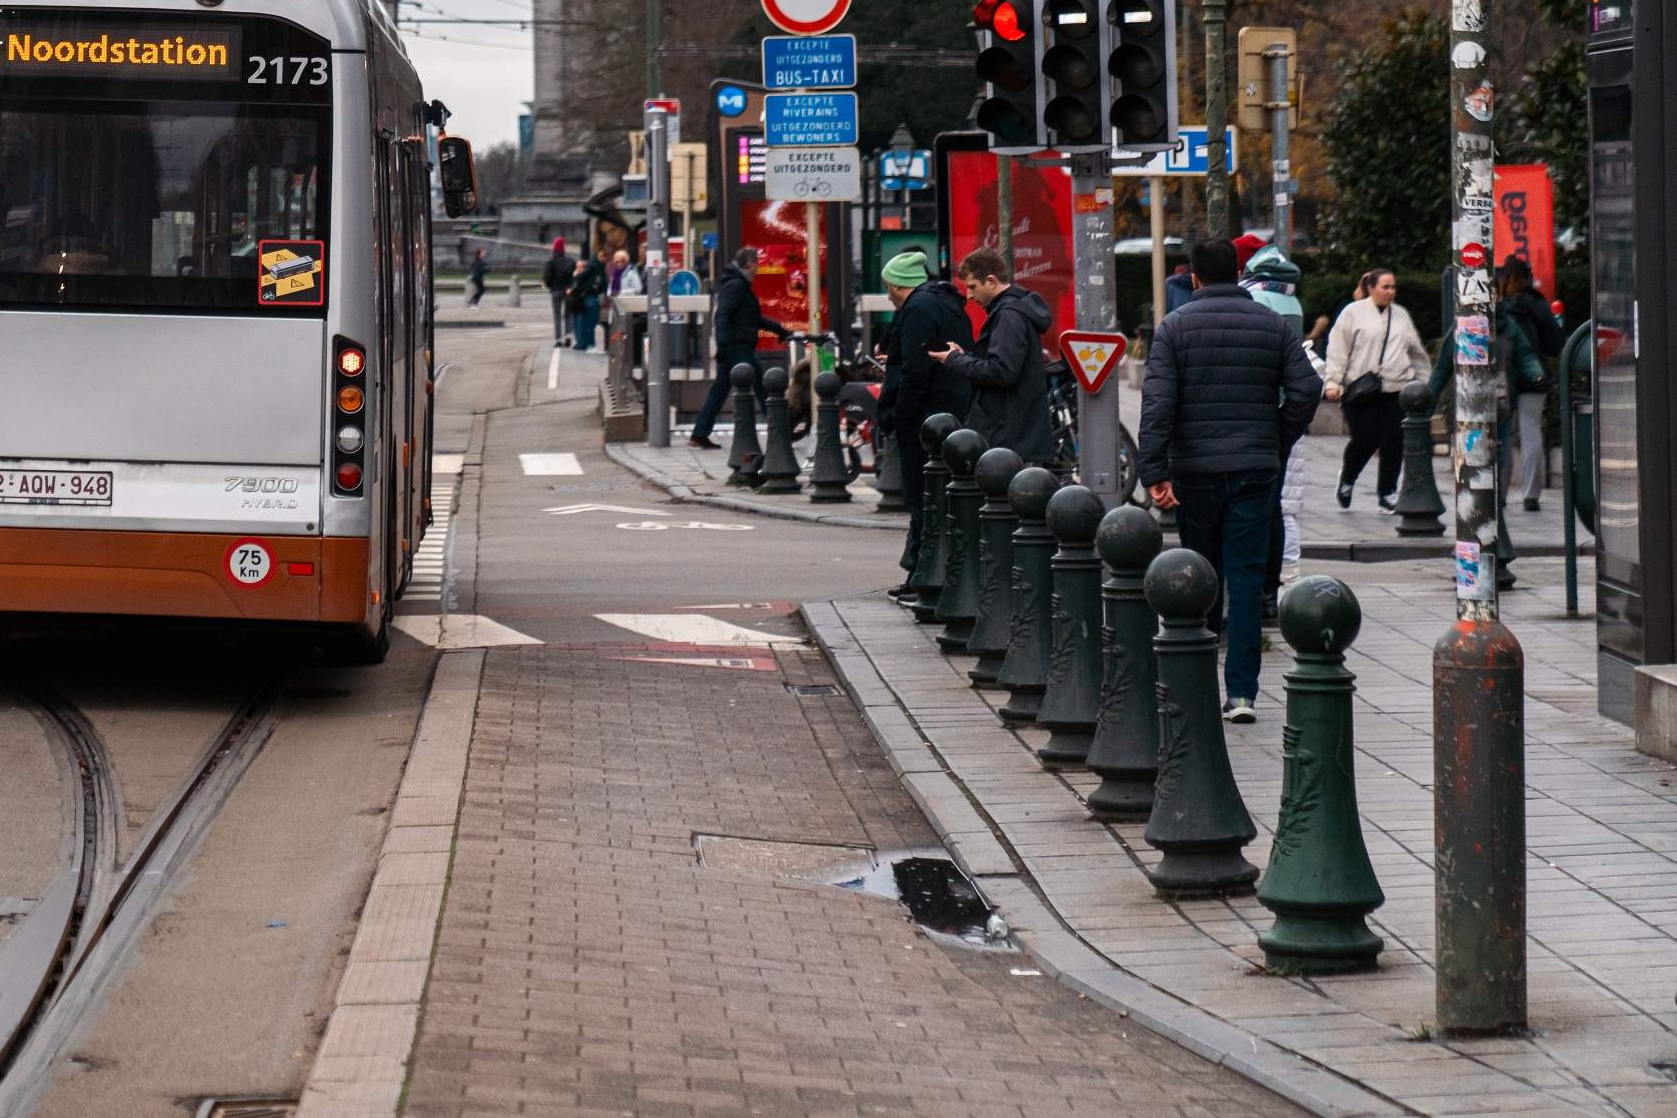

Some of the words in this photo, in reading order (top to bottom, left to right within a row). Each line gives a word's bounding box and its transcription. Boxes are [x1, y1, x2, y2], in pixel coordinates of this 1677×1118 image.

[7, 33, 227, 67] Noordstation
[787, 40, 831, 51] EXCEPTE
[776, 53, 843, 66] UITGEZONDERD
[247, 55, 329, 85] 2173
[775, 69, 844, 86] BUS-TAXI
[785, 97, 835, 107] EXCEPTE
[782, 108, 839, 118] RIVERAINS
[771, 121, 851, 133] UITGEZONDERD
[781, 132, 841, 143] BEWONERS
[788, 152, 836, 162] EXCEPTE
[773, 163, 851, 174] UITGEZONDERD
[224, 476, 299, 494] 7900
[241, 499, 299, 510] HYBRID
[239, 549, 262, 566] 75
[239, 567, 260, 578] Km
